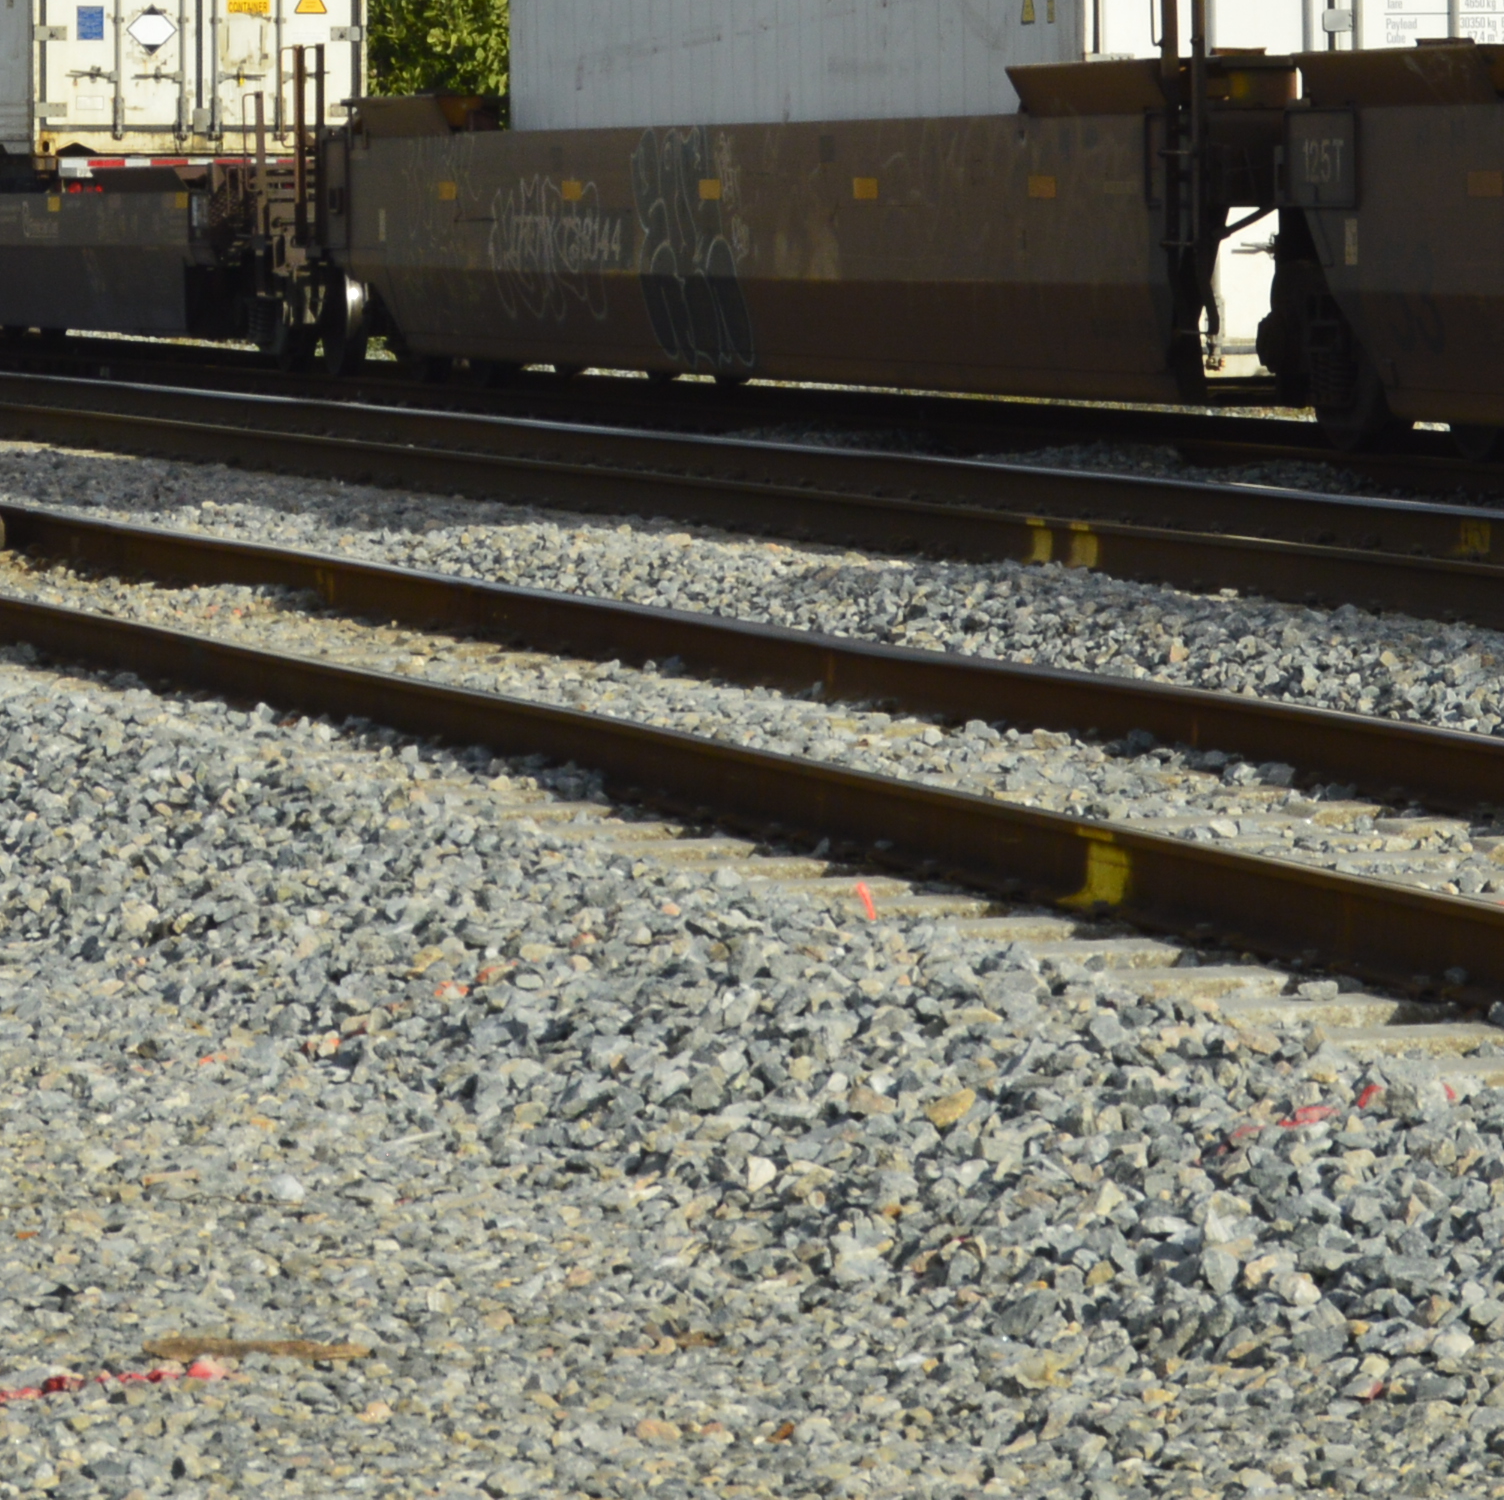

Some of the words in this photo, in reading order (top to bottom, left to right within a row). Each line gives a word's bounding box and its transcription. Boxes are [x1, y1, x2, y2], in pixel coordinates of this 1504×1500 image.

[228, 1, 268, 13] CONTAINER
[1385, 17, 1418, 32] Payload
[1459, 17, 1486, 29] 30350
[1487, 16, 1497, 32] kg
[1386, 31, 1406, 44] Cube
[1302, 138, 1345, 182] 125T
